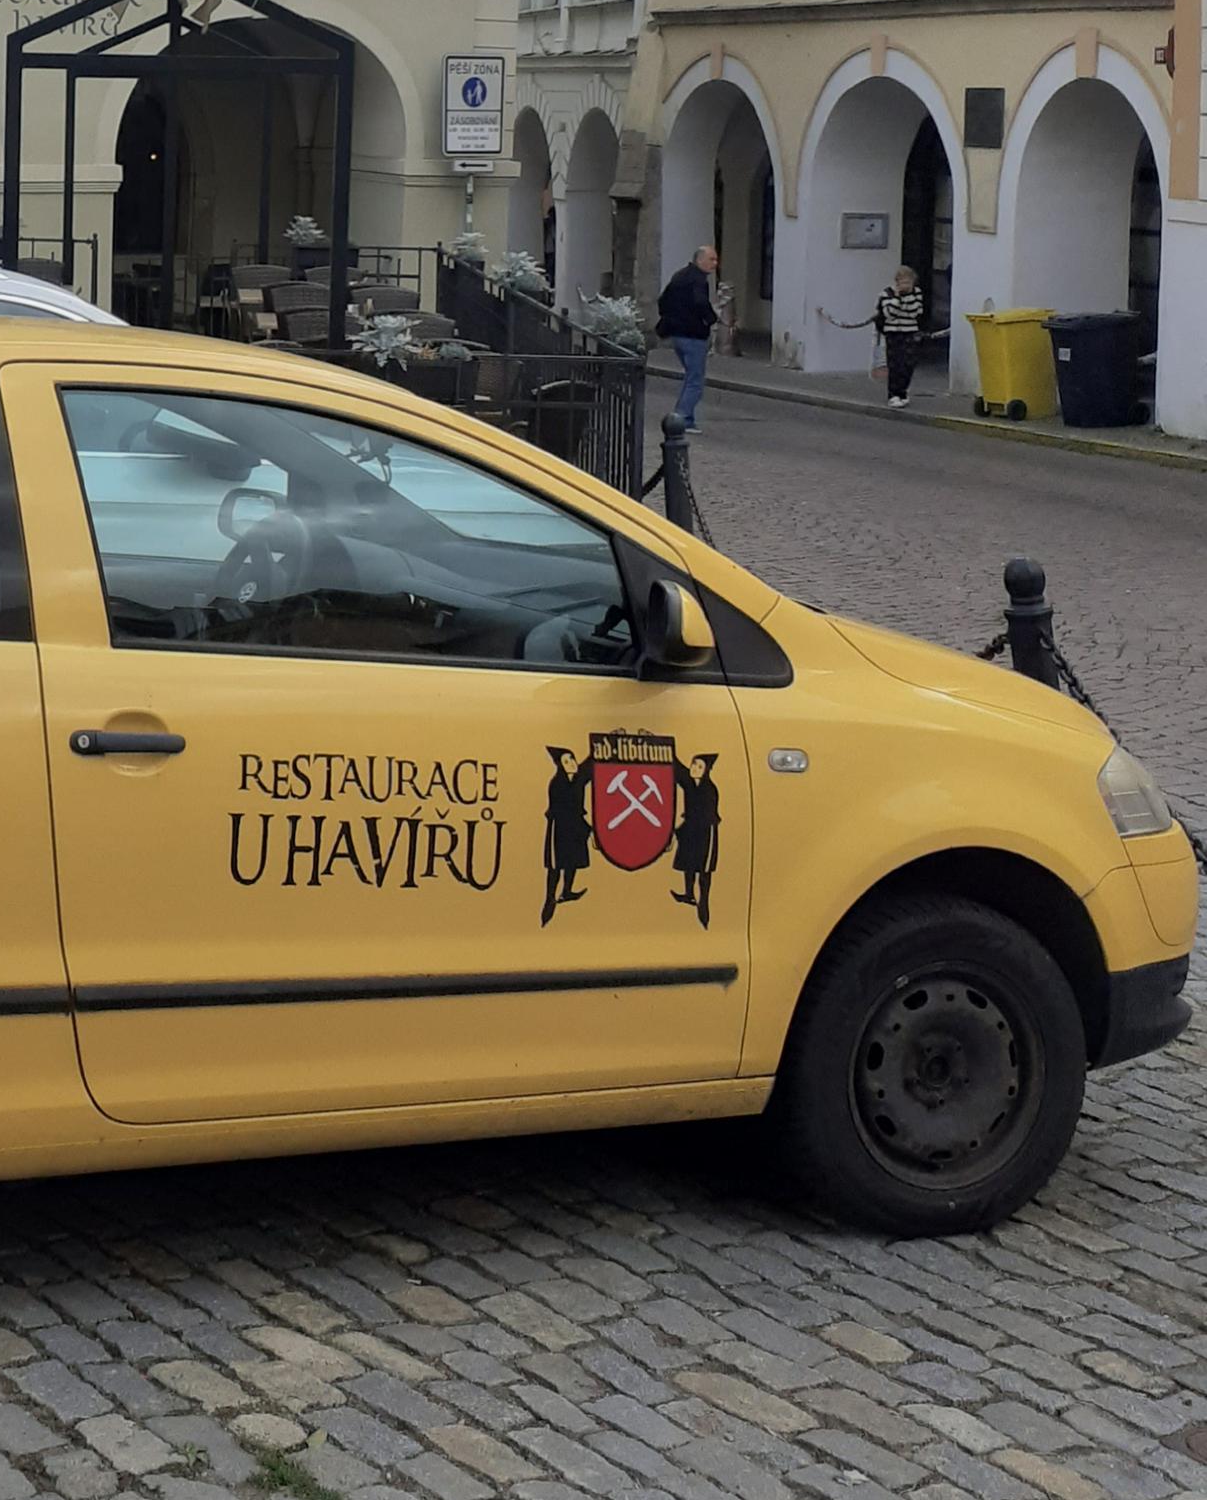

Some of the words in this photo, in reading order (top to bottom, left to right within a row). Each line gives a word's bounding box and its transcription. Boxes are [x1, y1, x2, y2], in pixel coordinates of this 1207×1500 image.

[238, 753, 500, 805] RESTAURACE
[228, 812, 274, 886] U
[281, 805, 508, 891] HAVÍŘŮ
